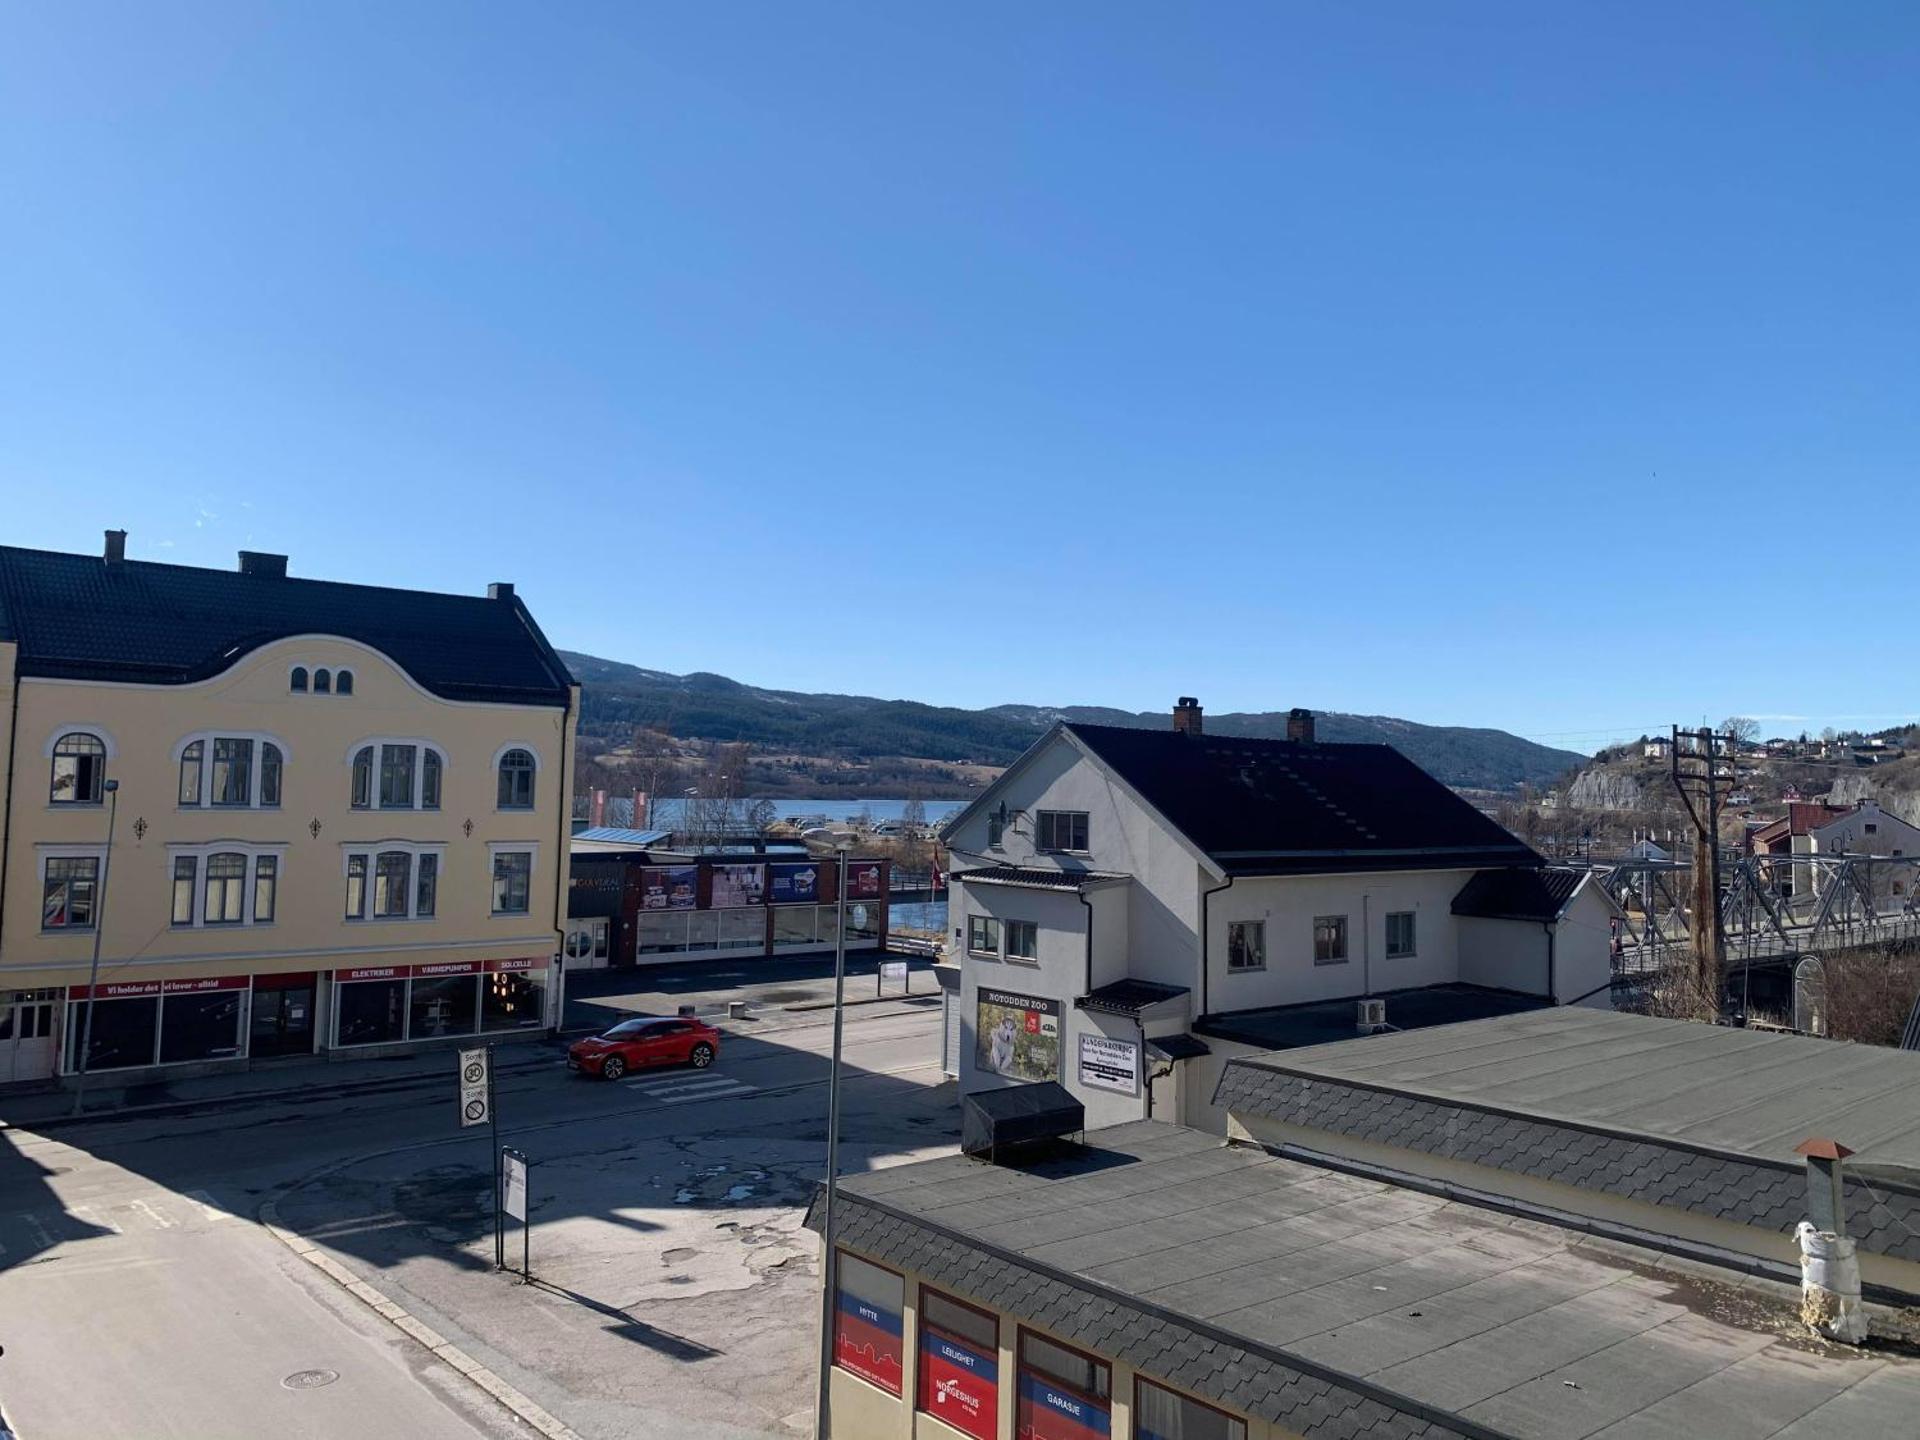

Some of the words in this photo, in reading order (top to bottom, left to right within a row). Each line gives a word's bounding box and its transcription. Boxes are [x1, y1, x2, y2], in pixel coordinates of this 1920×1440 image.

[351, 969, 394, 978] ELEKTRIKER
[421, 964, 472, 974] VARMEPUMPER
[989, 992, 1030, 1007] NOTODDEN
[1031, 1000, 1048, 1011] ZOO
[468, 1066, 481, 1079] 30
[859, 1306, 878, 1322] HYTTE
[941, 1345, 975, 1367] LEILIGHET
[936, 1379, 979, 1409] NORGESHUS
[1046, 1393, 1081, 1416] GARASJE
